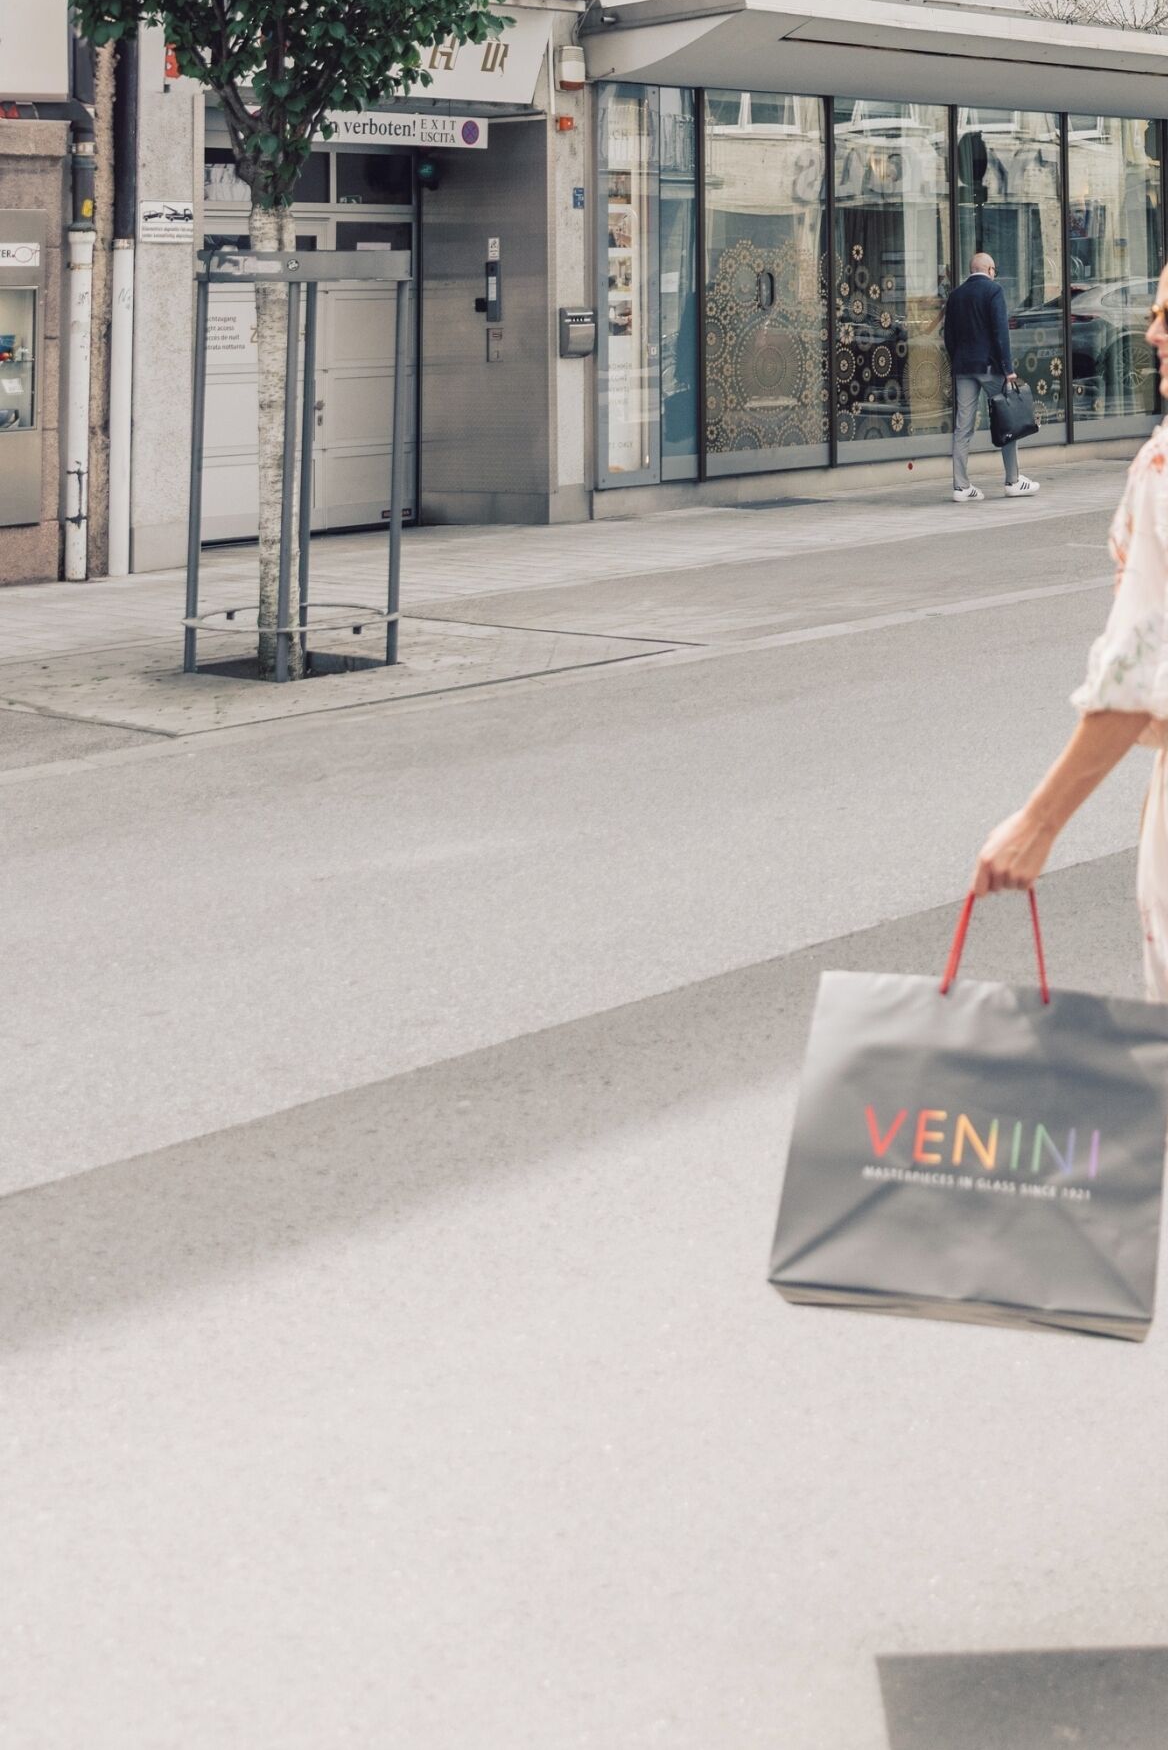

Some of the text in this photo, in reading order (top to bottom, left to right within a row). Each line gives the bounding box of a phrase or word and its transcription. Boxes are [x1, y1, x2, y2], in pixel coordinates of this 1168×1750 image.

[343, 117, 417, 138] verboten!
[420, 131, 457, 144] USCITA
[864, 1103, 1101, 1180] VENINI
[861, 1165, 1091, 1201] MASTERPIECES IN GLASS SINCE 1921
